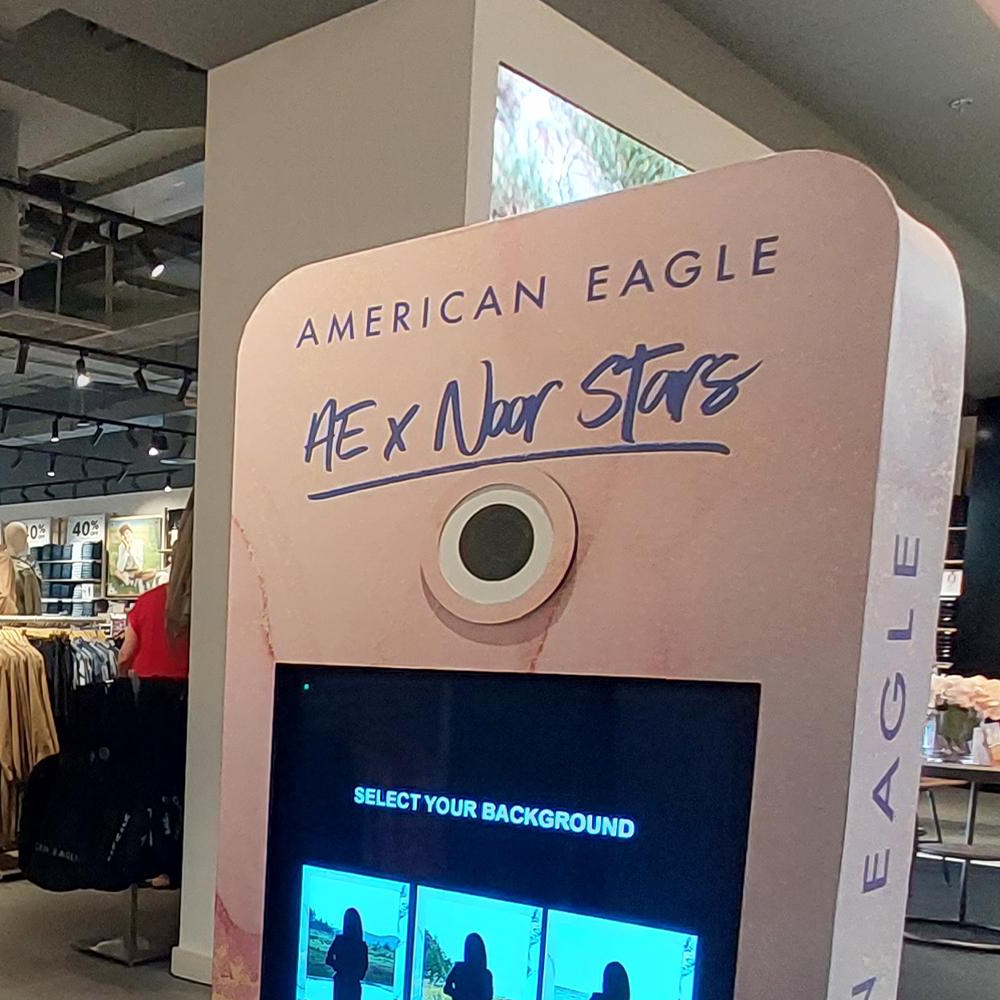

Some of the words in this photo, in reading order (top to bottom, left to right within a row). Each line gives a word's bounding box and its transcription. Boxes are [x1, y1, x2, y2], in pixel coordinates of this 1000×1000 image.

[296, 276, 546, 349] AMERICAN
[586, 235, 780, 302] EAGLE
[303, 398, 377, 472] AE
[433, 358, 563, 457] Noor
[577, 342, 764, 444] Stars
[27, 524, 46, 540] 0%
[72, 520, 100, 536] 40%
[862, 534, 921, 894] EAGLE
[354, 786, 421, 811] SELECT
[423, 796, 477, 819] YOUR
[481, 802, 636, 839] BACKGROUND
